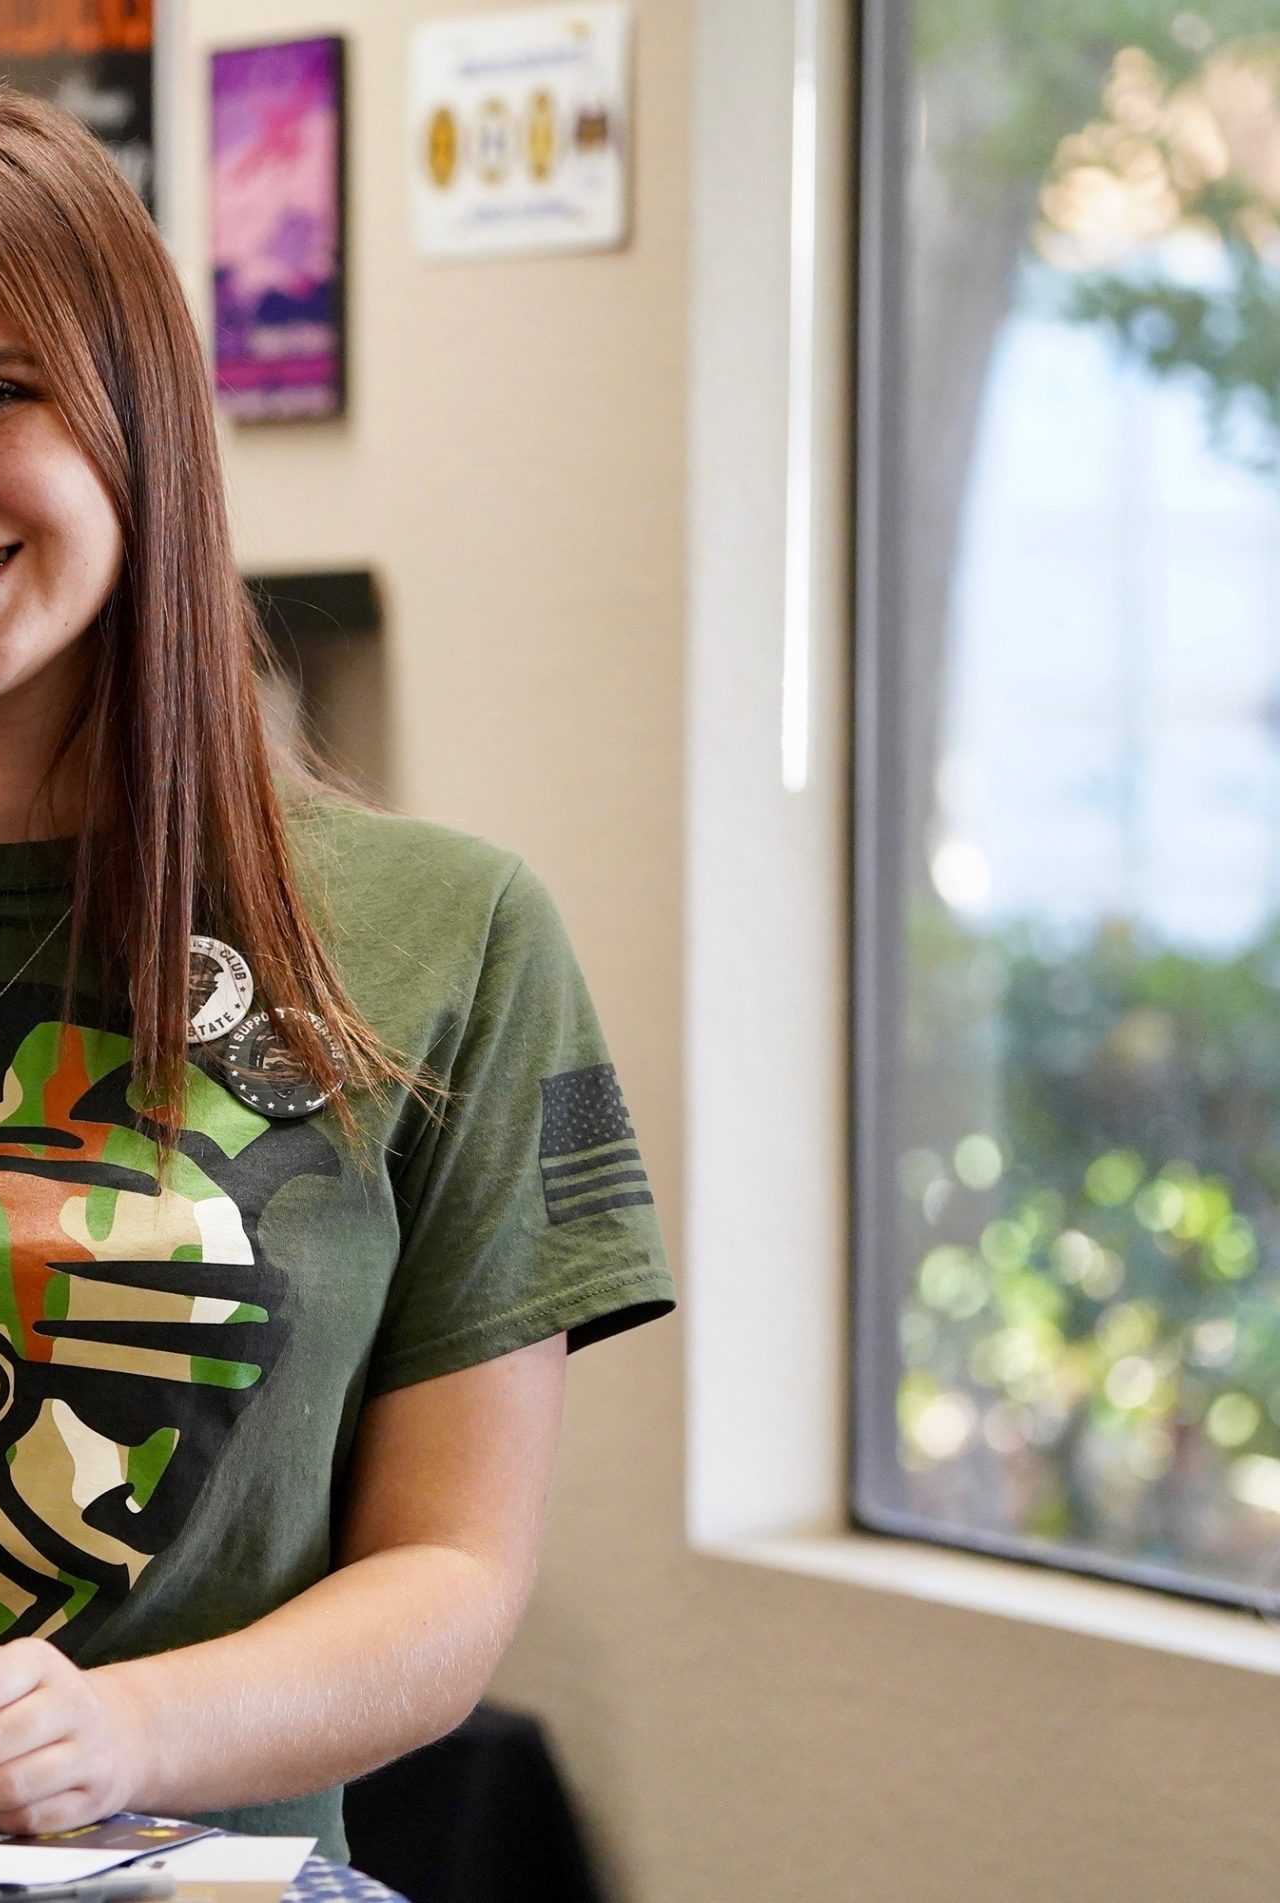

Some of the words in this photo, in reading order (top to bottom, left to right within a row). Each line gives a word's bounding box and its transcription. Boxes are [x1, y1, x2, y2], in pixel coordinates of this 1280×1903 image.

[220, 948, 246, 980] CLUB
[188, 1012, 234, 1038] STATE
[233, 1007, 285, 1042] SUPPOT
